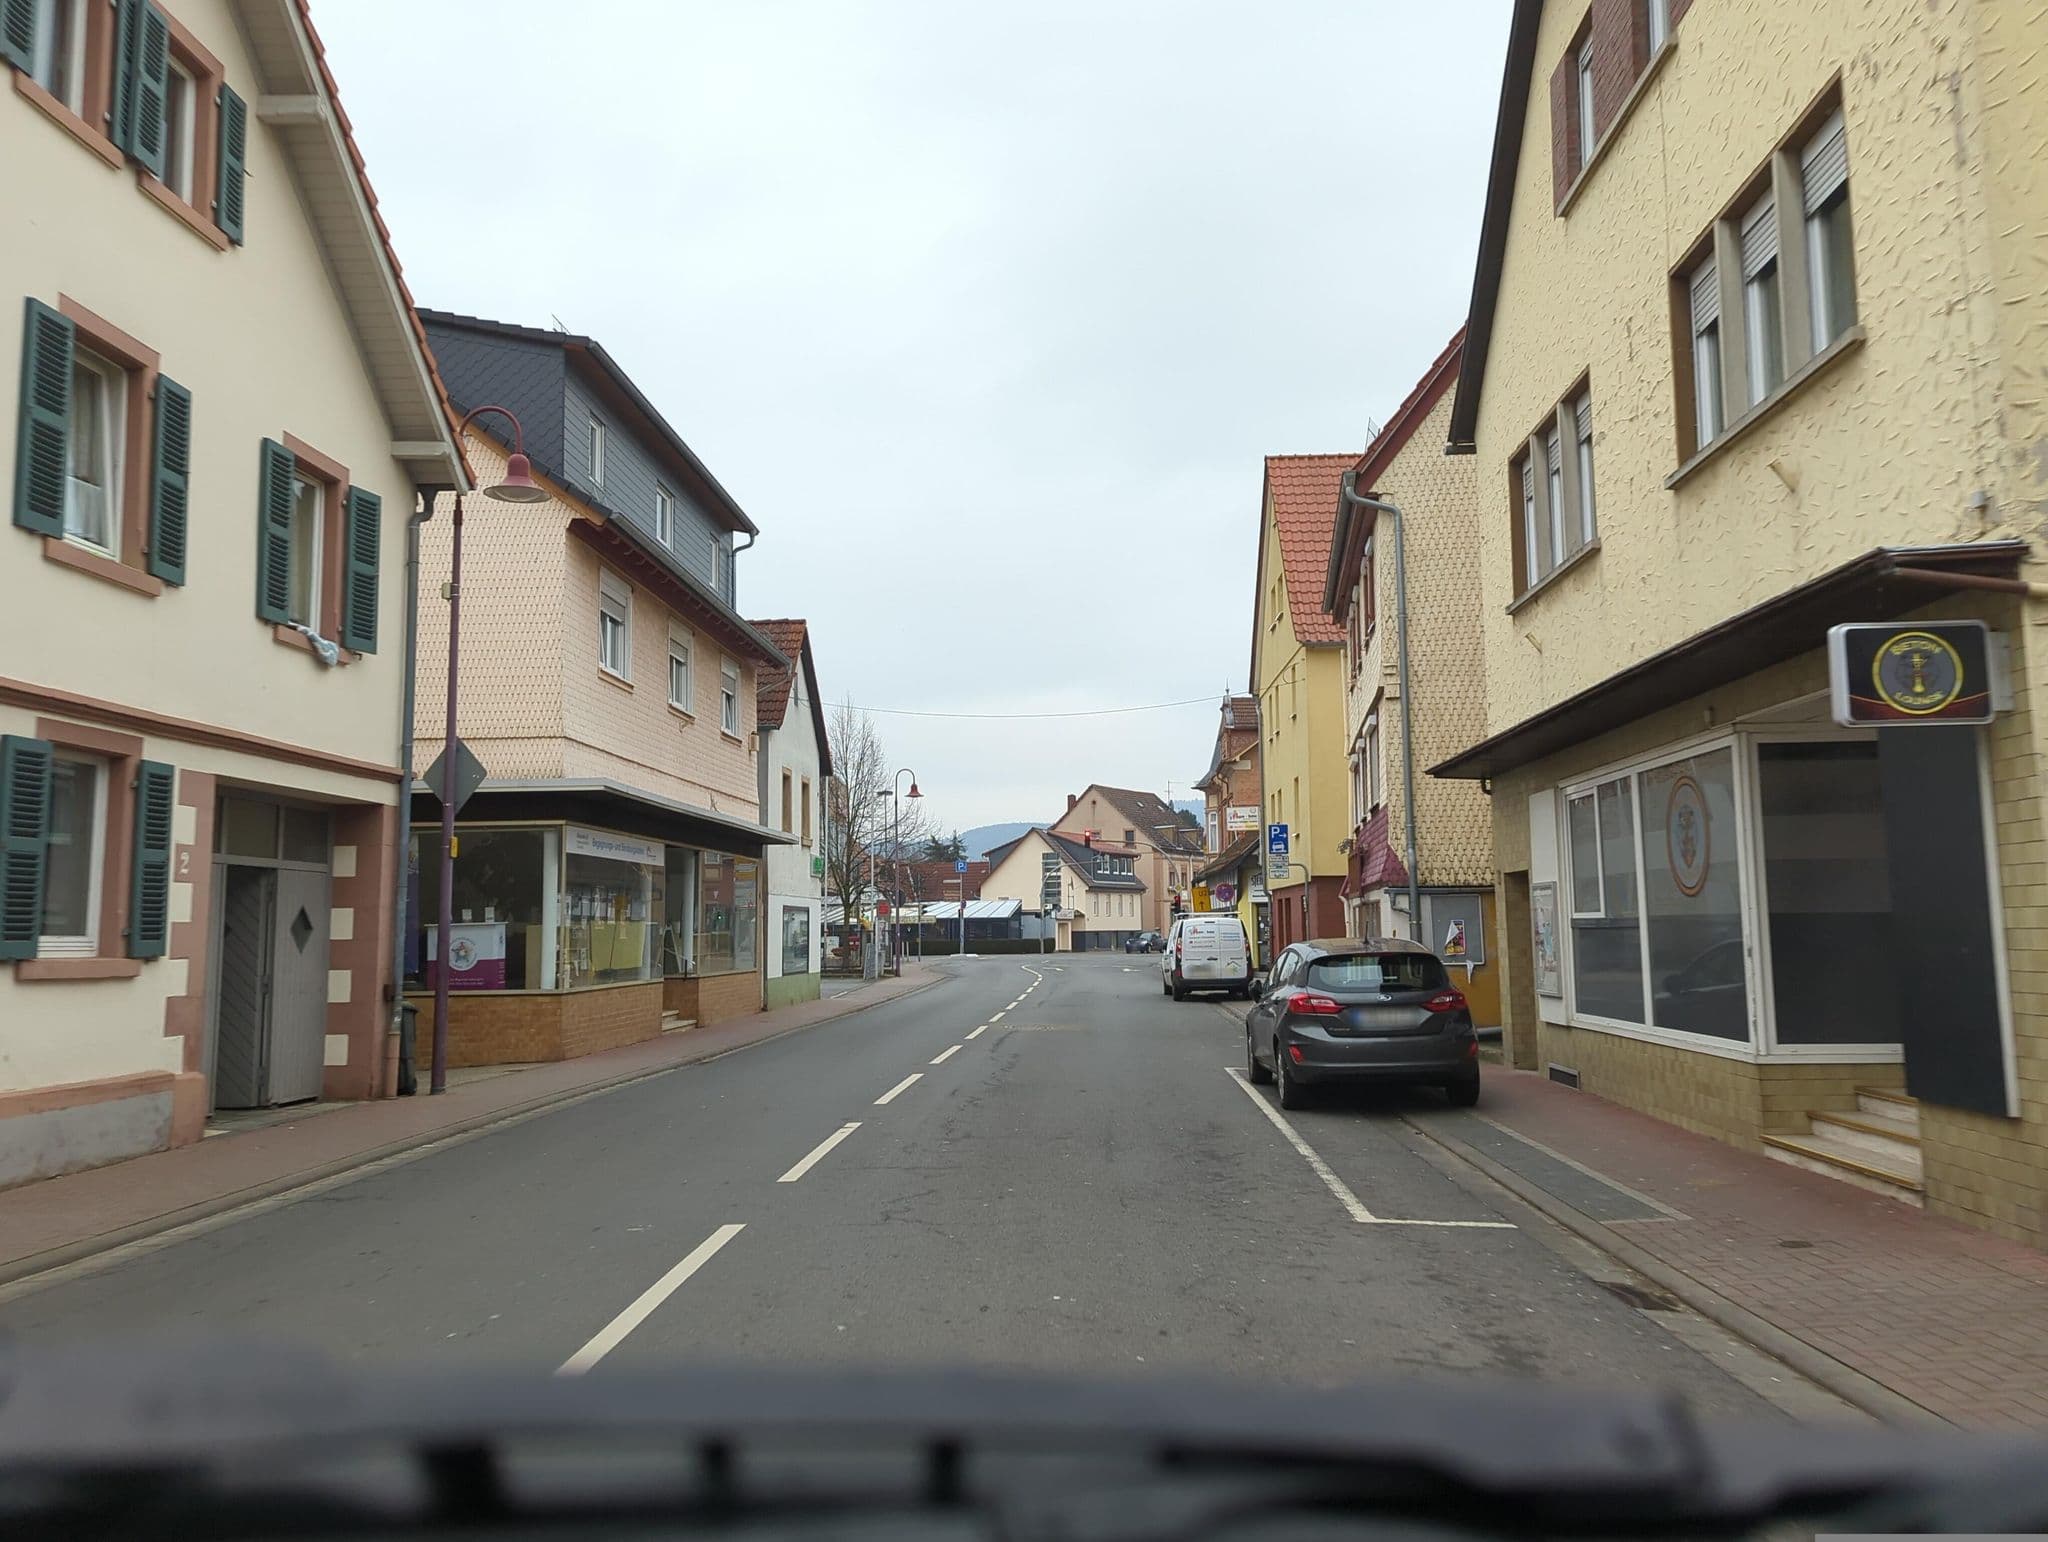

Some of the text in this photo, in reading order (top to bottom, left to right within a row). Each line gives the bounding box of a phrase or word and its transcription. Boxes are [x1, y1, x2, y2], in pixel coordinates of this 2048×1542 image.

[1271, 827, 1280, 838] P
[180, 852, 190, 874] 2
[958, 862, 964, 870] P
